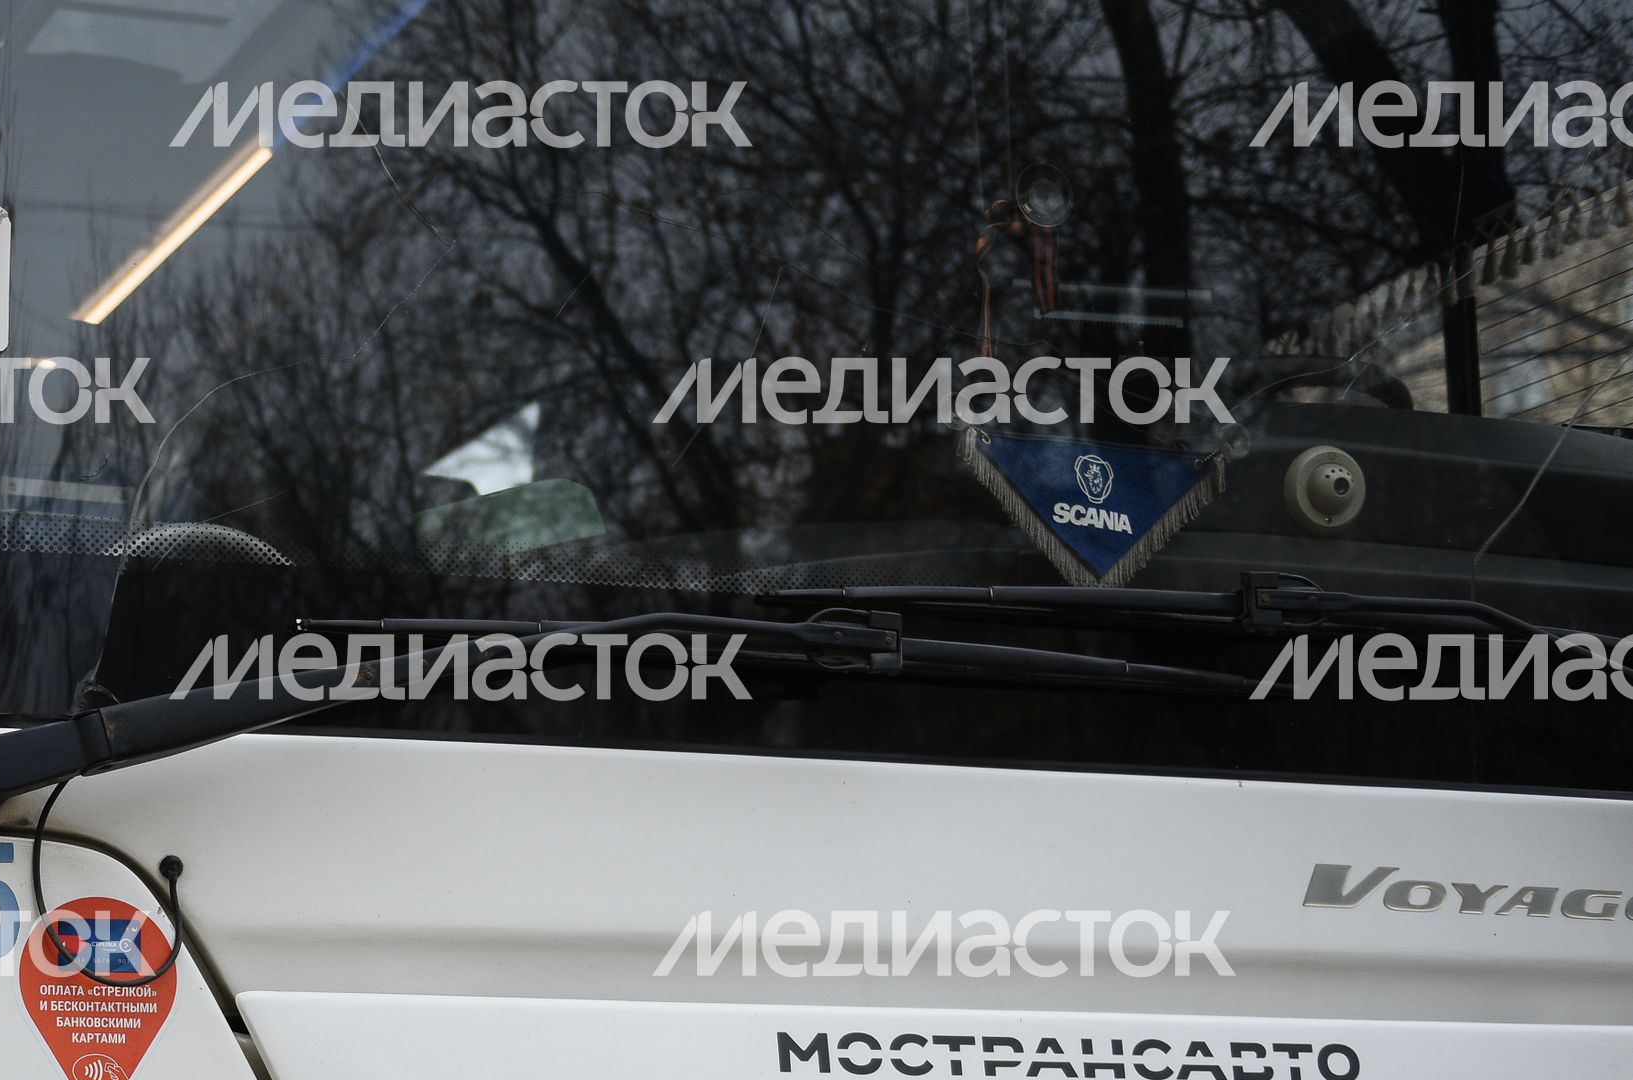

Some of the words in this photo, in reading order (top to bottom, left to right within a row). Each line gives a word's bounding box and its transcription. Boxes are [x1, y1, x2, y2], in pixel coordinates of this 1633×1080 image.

[1052, 502, 1133, 535] SCANIA
[1302, 863, 1633, 922] VOYAG
[39, 984, 85, 997] ОПЛАТА
[87, 985, 158, 998] «СТРЕЛКОЙ»
[39, 1000, 48, 1012] И
[50, 1001, 158, 1014] БЕСКОНТАКТНЫМИ
[56, 1016, 141, 1029] БАНКОВСКИМИ
[71, 1032, 126, 1045] КАРТАМИ
